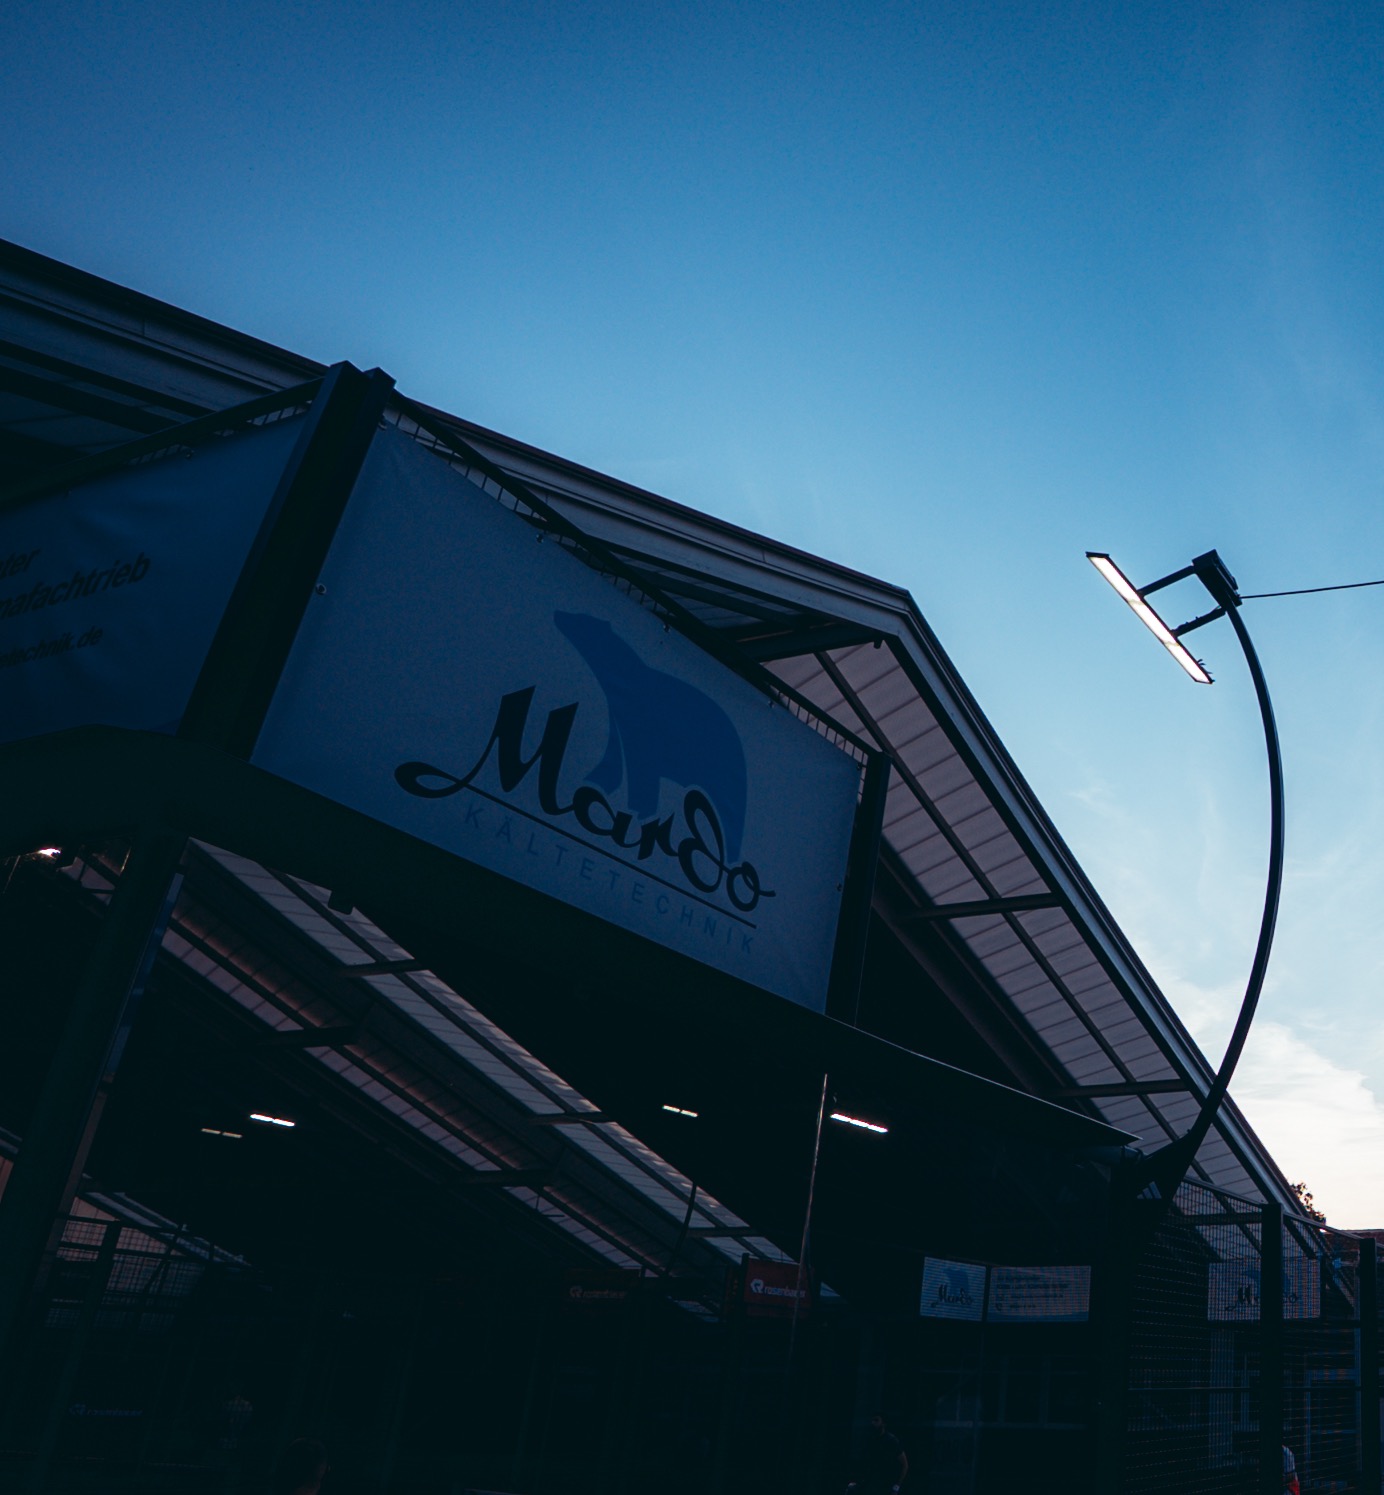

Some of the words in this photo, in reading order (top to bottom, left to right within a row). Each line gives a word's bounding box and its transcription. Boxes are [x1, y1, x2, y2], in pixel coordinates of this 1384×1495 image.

[0, 549, 41, 579] ter
[395, 685, 776, 912] Mardo
[464, 804, 754, 954] KÄLTETECHNIK
